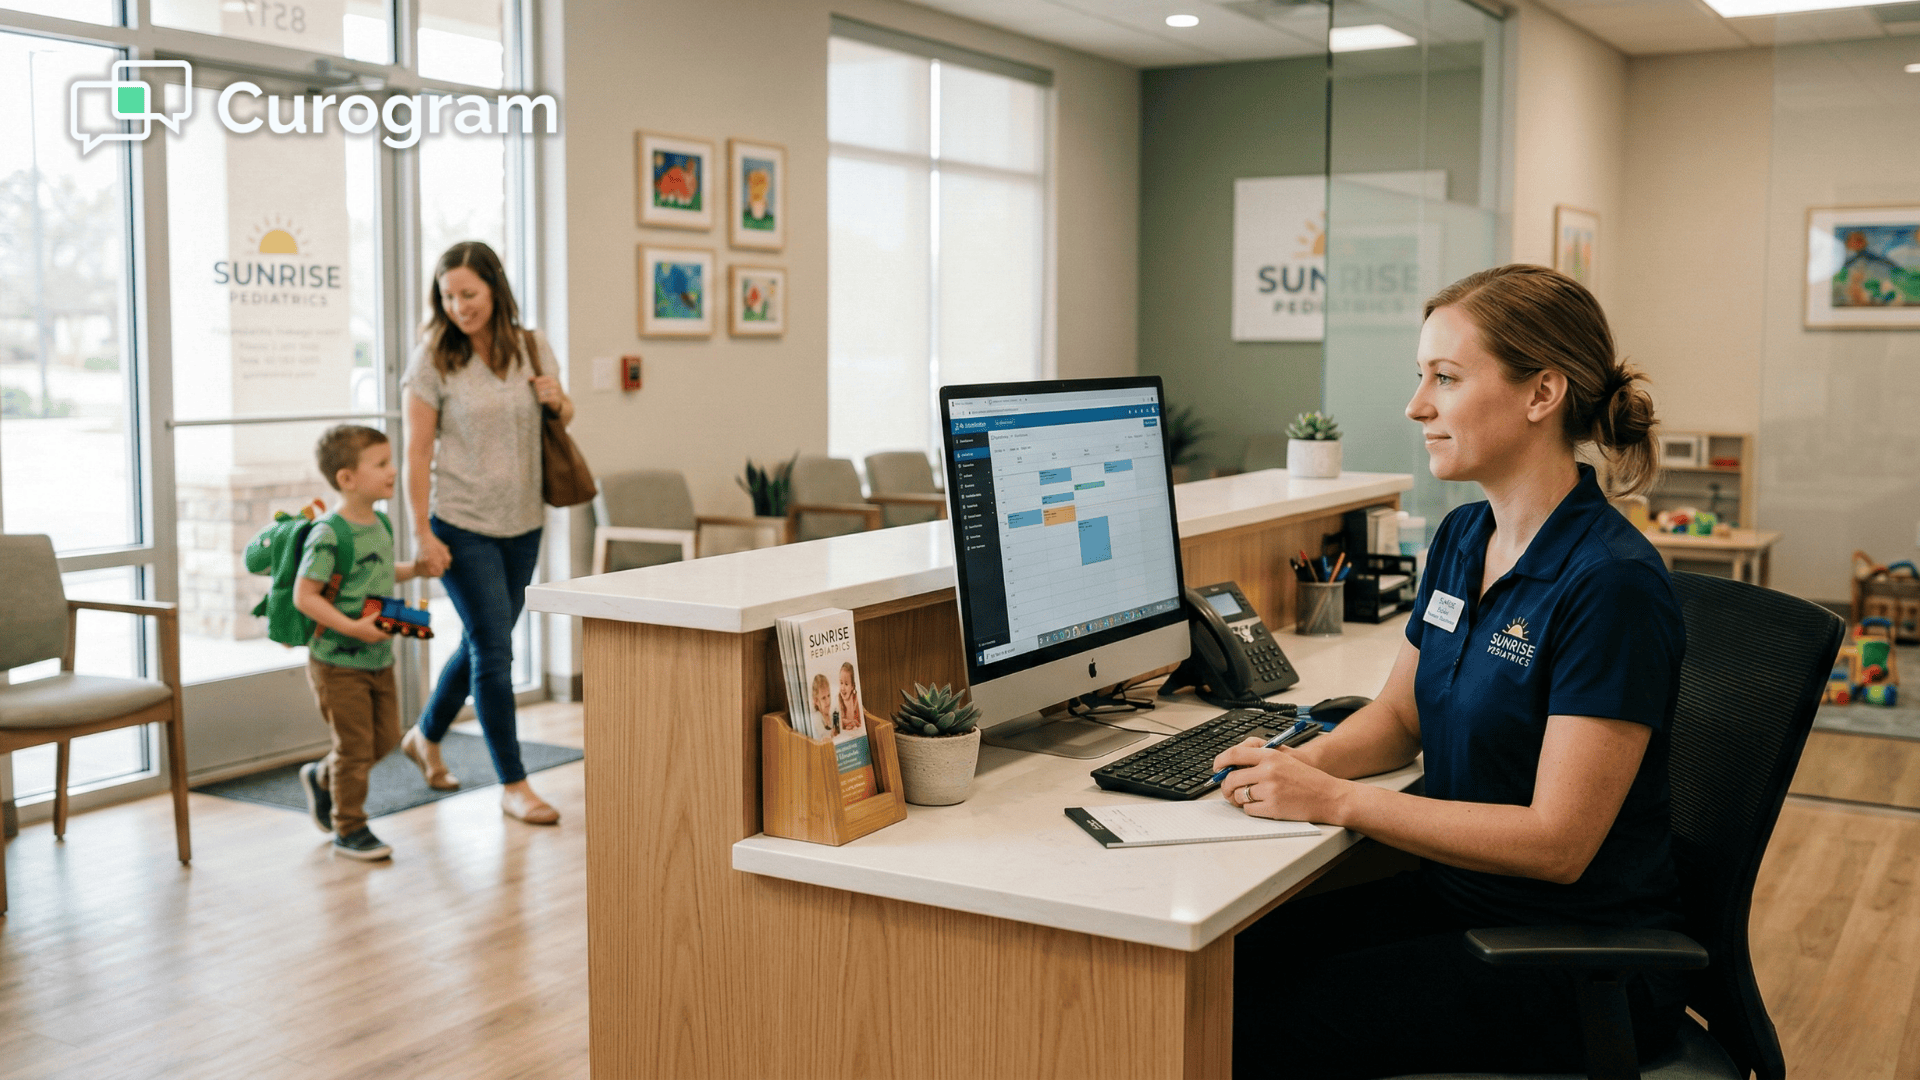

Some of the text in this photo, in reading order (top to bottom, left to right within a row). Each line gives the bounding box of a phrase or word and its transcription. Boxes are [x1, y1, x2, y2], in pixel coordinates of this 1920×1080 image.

[213, 261, 342, 289] SUNRISE
[229, 291, 329, 307] PEDIATRICS
[809, 626, 850, 648] SUNRISE
[1490, 632, 1536, 658] SUNRISE
